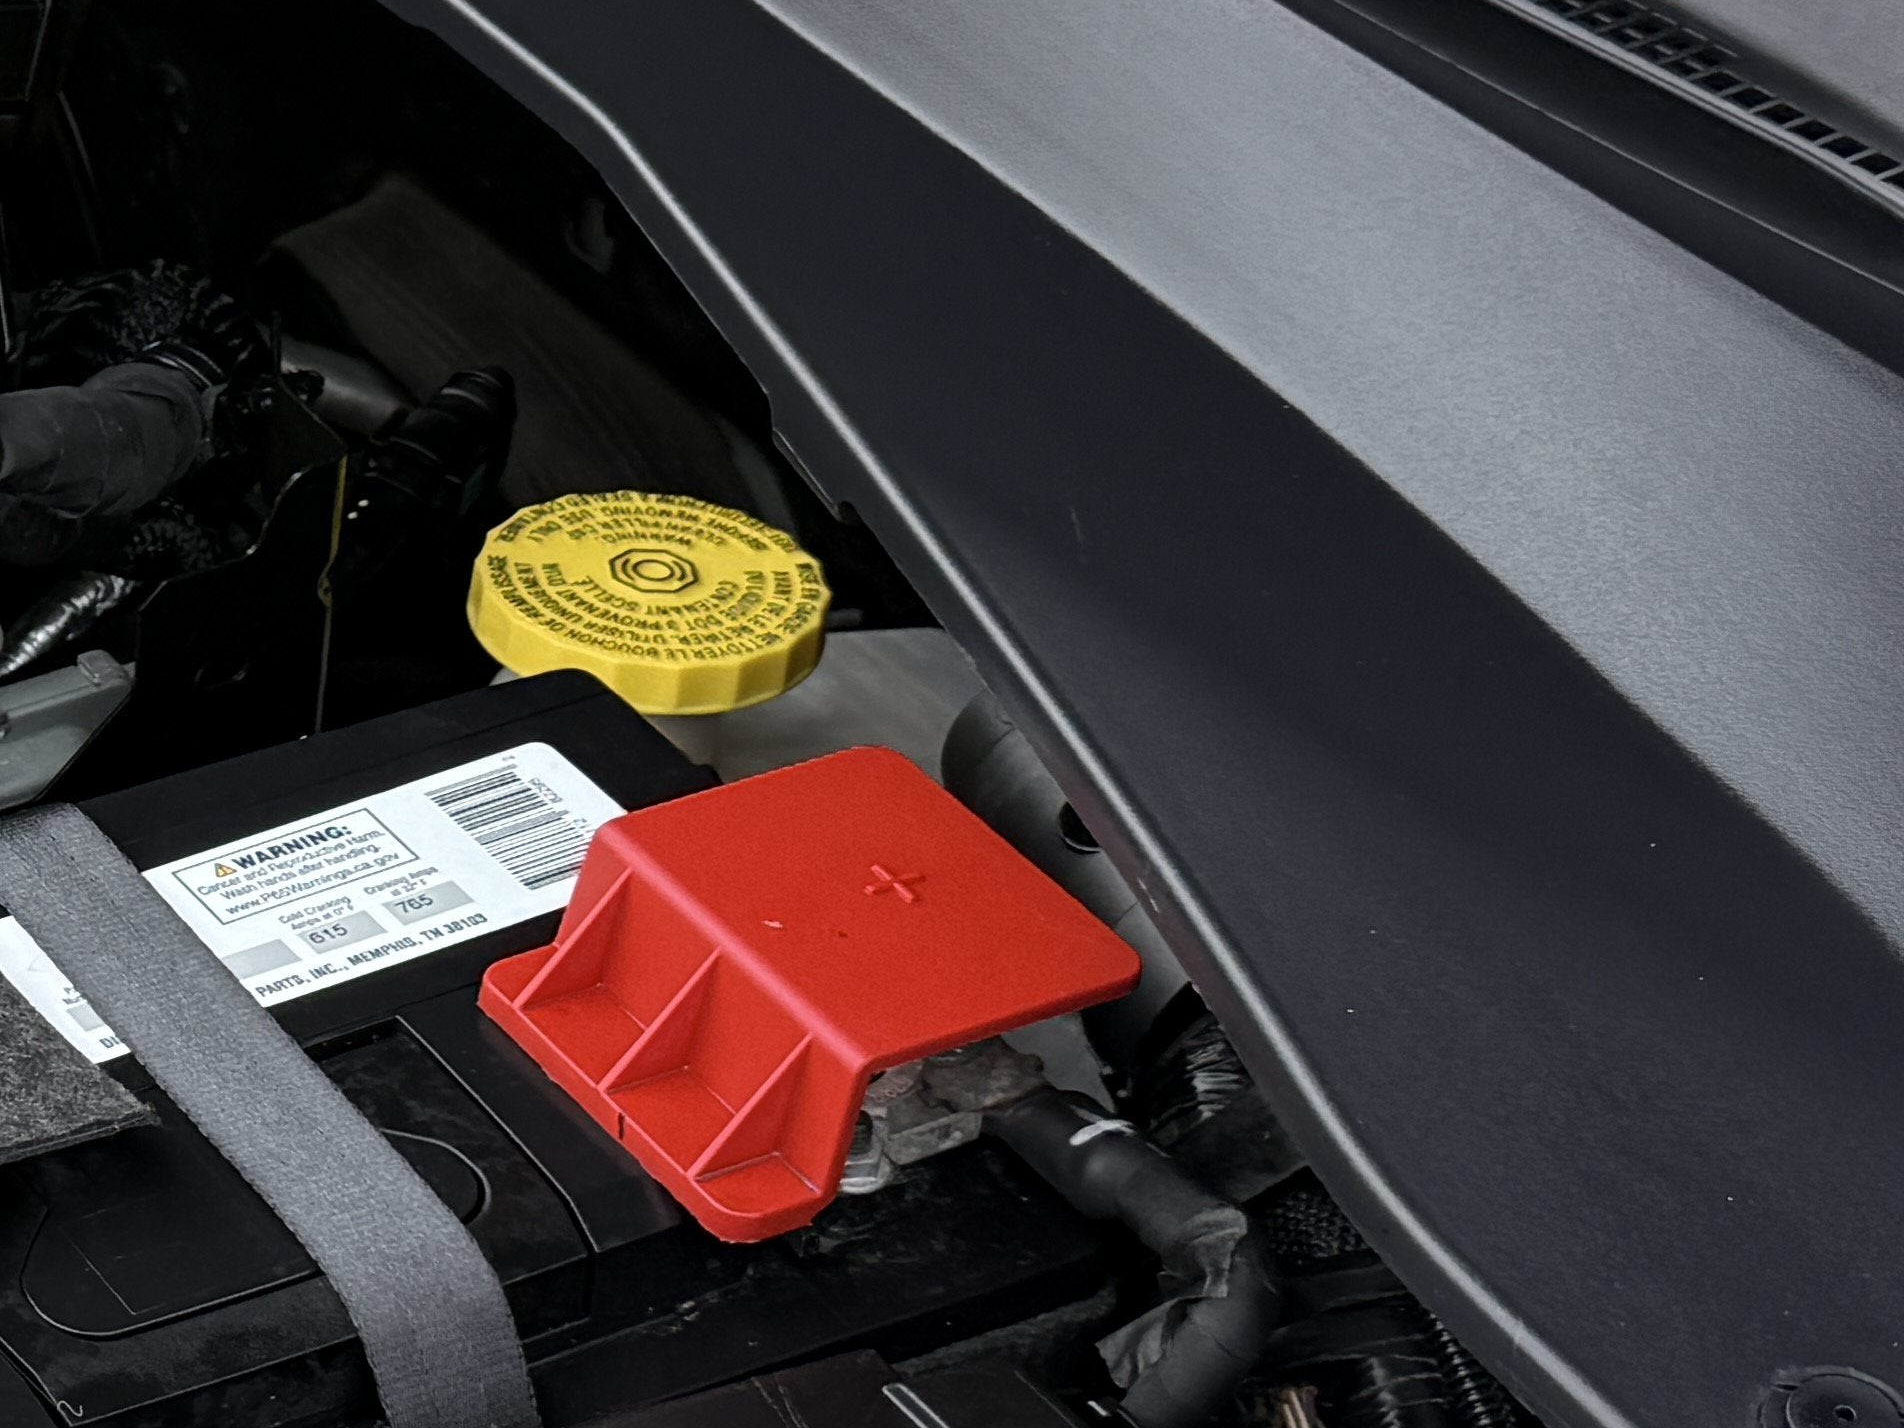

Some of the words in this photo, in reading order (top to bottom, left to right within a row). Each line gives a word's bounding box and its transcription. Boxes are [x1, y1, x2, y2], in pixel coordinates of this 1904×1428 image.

[682, 614, 726, 631] DOT
[561, 627, 659, 658] BOUCHON
[663, 647, 688, 659] LE
[233, 825, 352, 869] WARNING:
[197, 877, 242, 896] Cancer
[245, 866, 268, 881] and
[269, 841, 346, 871] Reproductive
[220, 884, 258, 900] Wash
[260, 871, 296, 889] hands
[298, 861, 324, 876] after
[394, 893, 434, 914] 765
[309, 923, 348, 944] 615
[255, 973, 312, 998] PARTS,
[346, 936, 424, 967] MEMPHIS,
[419, 927, 445, 942] TN
